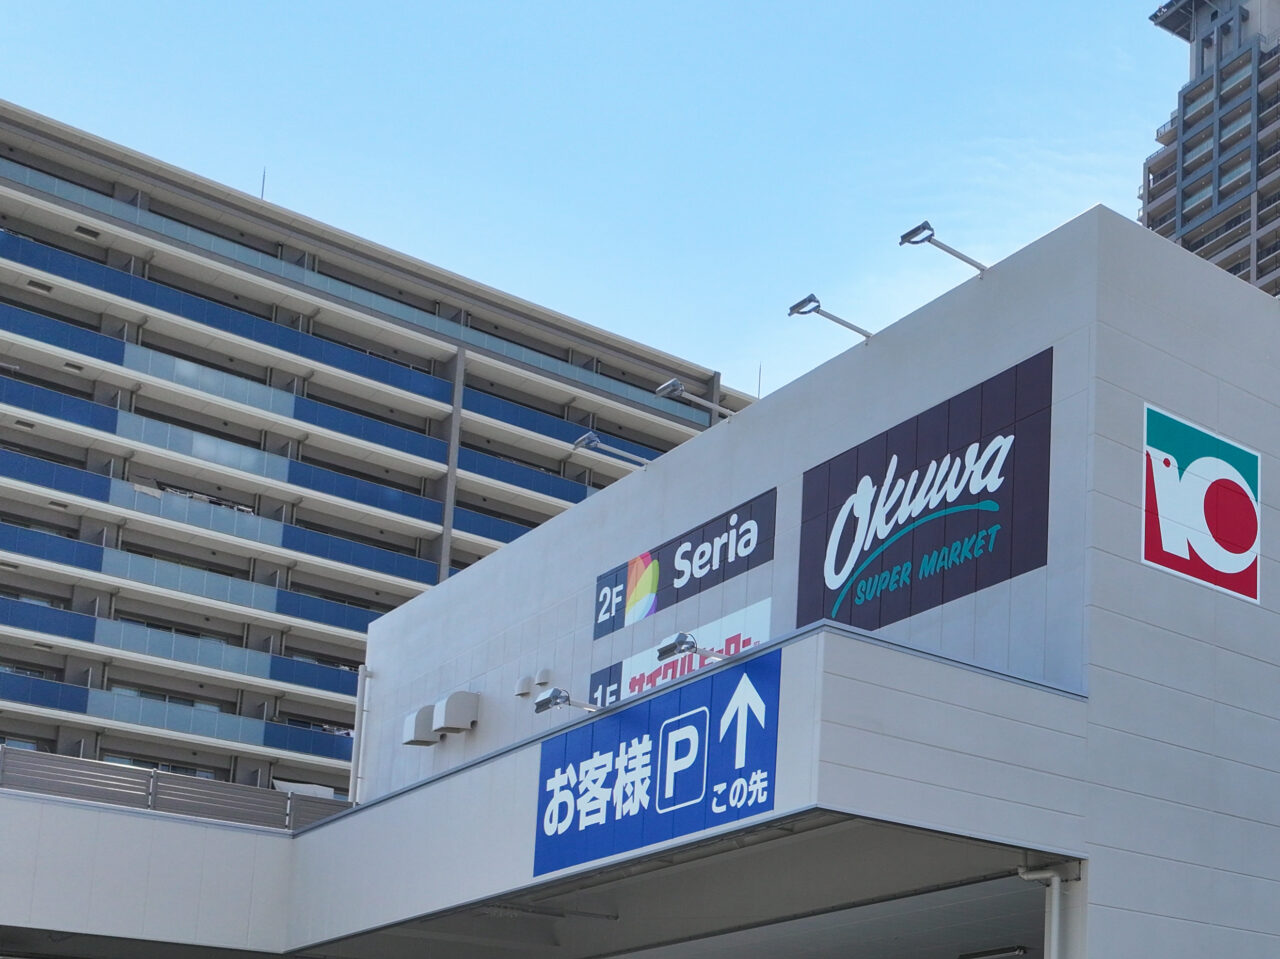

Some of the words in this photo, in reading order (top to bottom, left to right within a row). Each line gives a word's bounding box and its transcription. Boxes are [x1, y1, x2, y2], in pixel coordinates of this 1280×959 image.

[824, 435, 1015, 590] Okuwa
[854, 561, 912, 605] SUPER
[919, 523, 1002, 580] MARKET
[597, 583, 624, 624] 2F
[673, 513, 759, 589] Seria
[543, 734, 653, 836] お客様
[665, 725, 699, 799] P
[711, 769, 768, 814] この先
